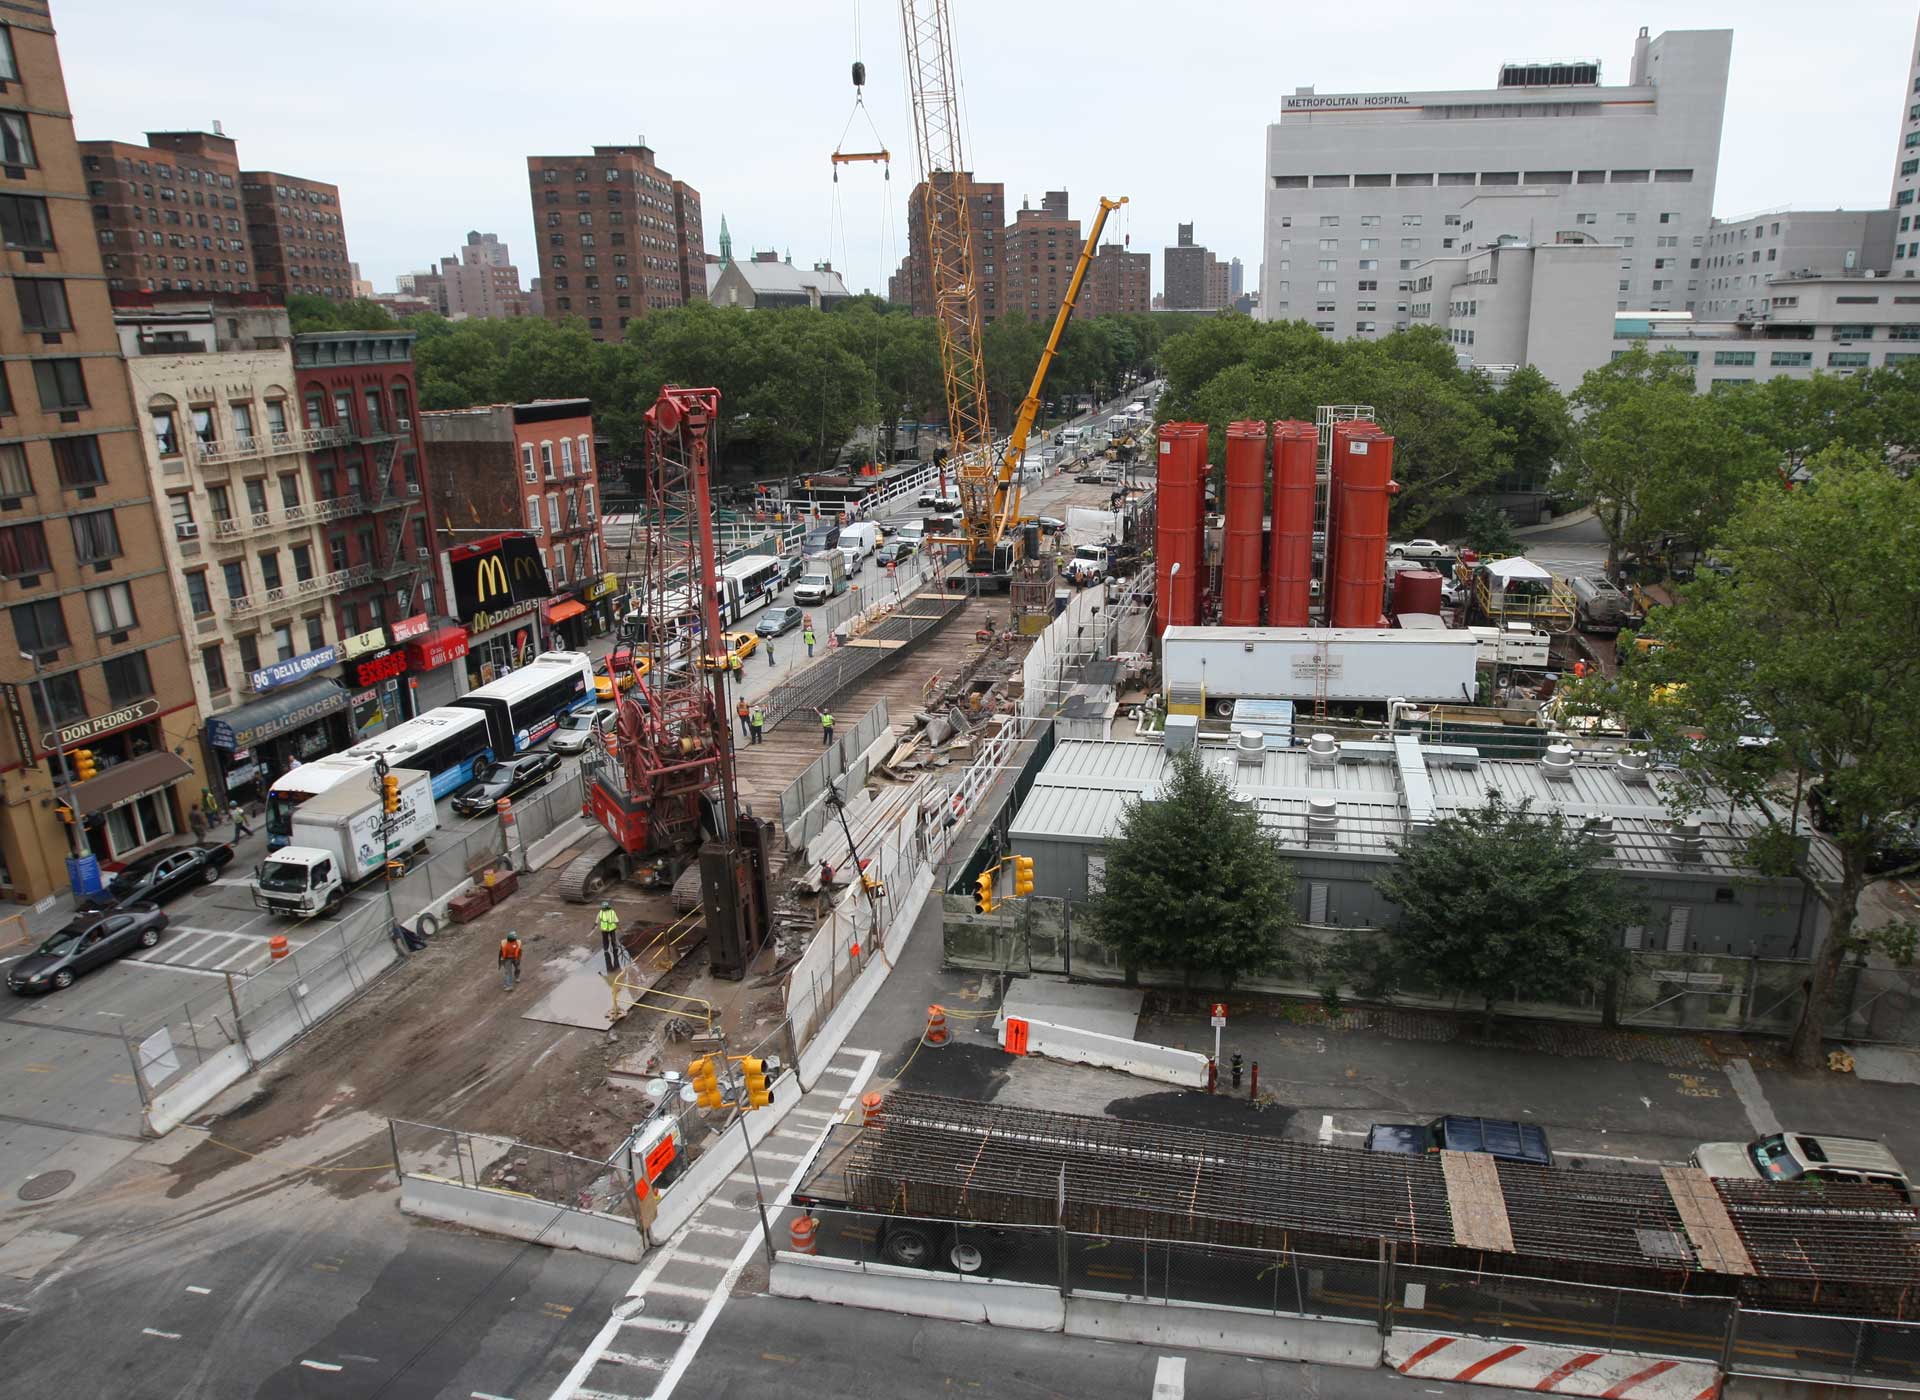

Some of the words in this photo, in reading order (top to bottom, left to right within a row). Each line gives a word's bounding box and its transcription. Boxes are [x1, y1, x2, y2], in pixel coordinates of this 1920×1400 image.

[1287, 97, 1358, 107] METROPOLITAN
[1364, 96, 1410, 105] HOSPITAL
[472, 599, 539, 634] McDonald's
[273, 664, 294, 679] DELI
[300, 648, 334, 671] GROCERY
[357, 650, 406, 675] CHECKS
[358, 661, 408, 687] CASHED
[351, 688, 378, 706] OPEN
[61, 723, 92, 742] DON
[93, 705, 144, 732] PEDRO'S
[256, 716, 286, 738] DELI
[288, 693, 345, 725] GROCERY
